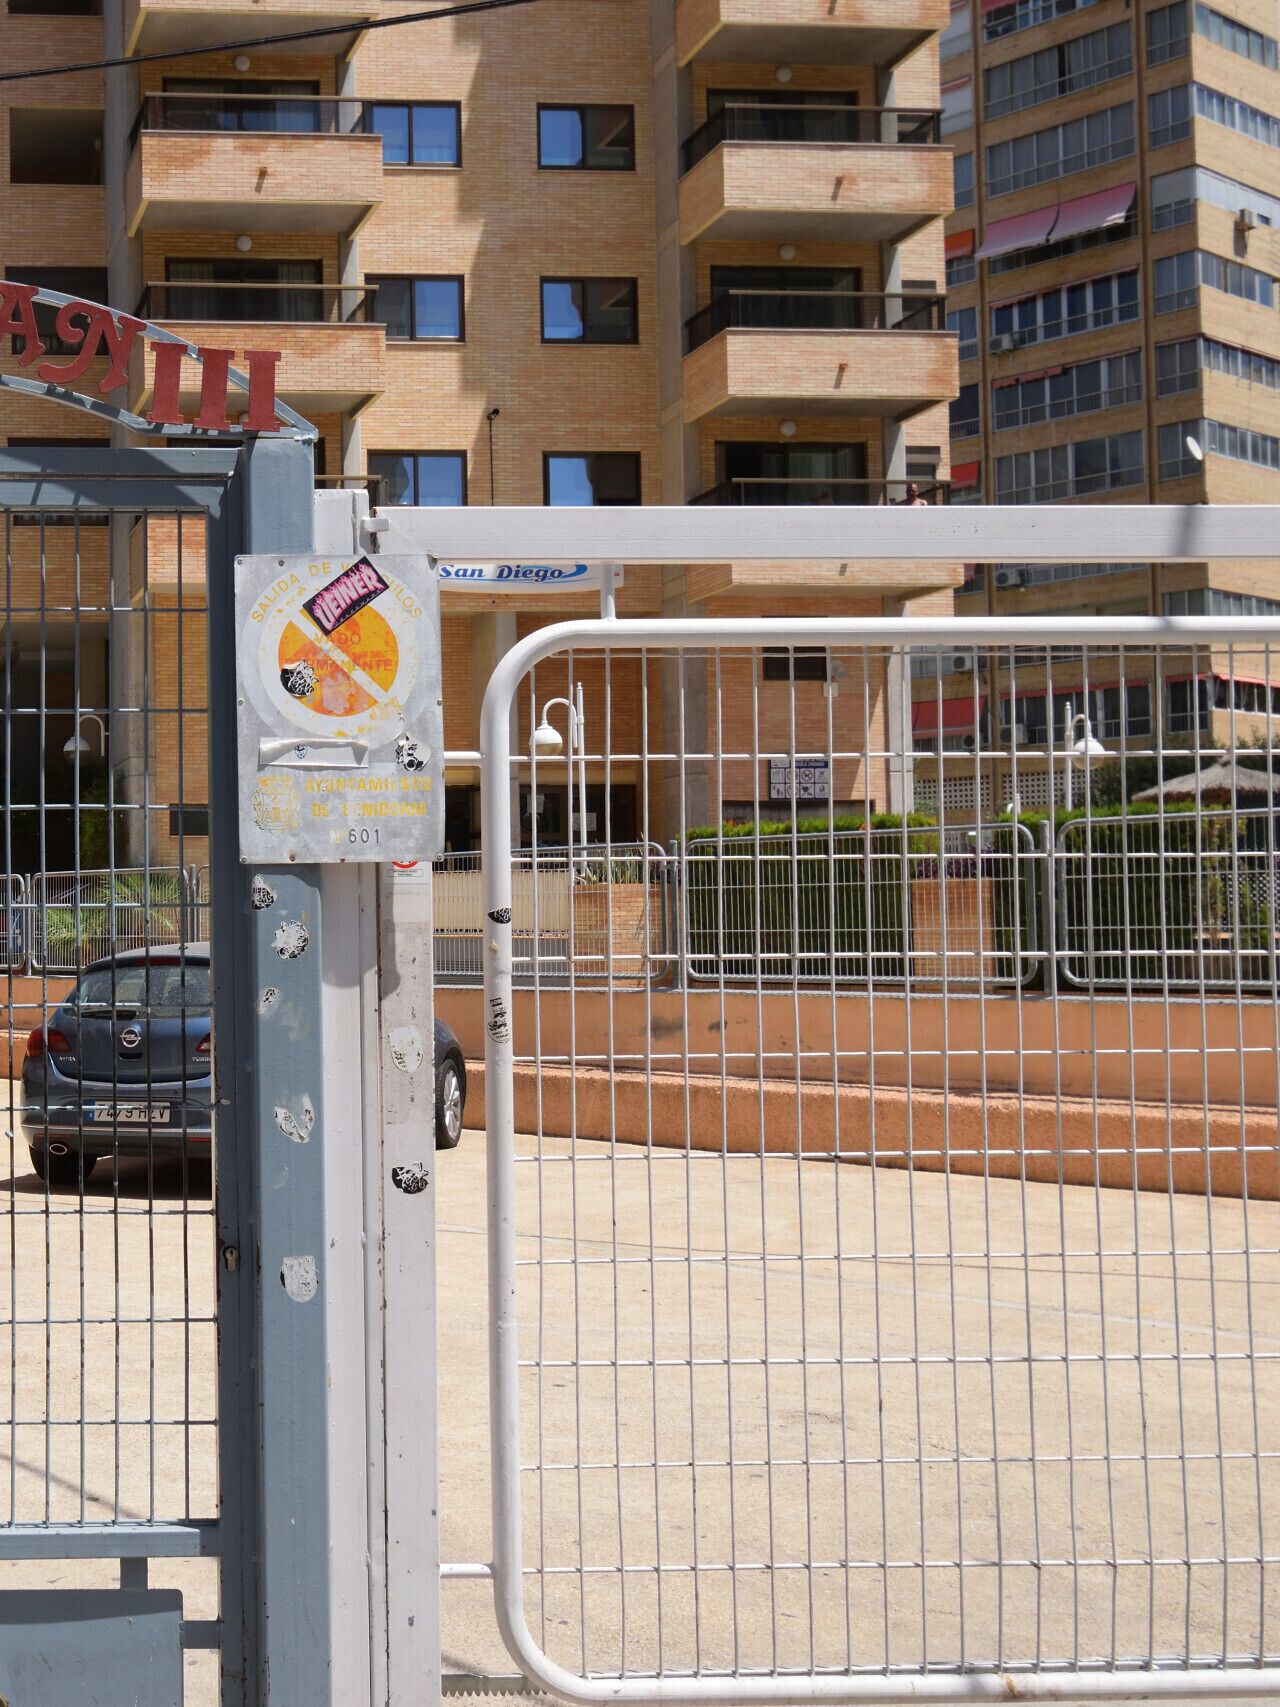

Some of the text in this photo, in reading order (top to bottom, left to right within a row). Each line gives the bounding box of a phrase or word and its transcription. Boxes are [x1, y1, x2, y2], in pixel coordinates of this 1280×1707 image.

[148, 340, 281, 431] III
[251, 573, 300, 623] SALIDA
[308, 561, 333, 577] DE
[439, 564, 564, 583] San Diego
[348, 828, 381, 844] 601
